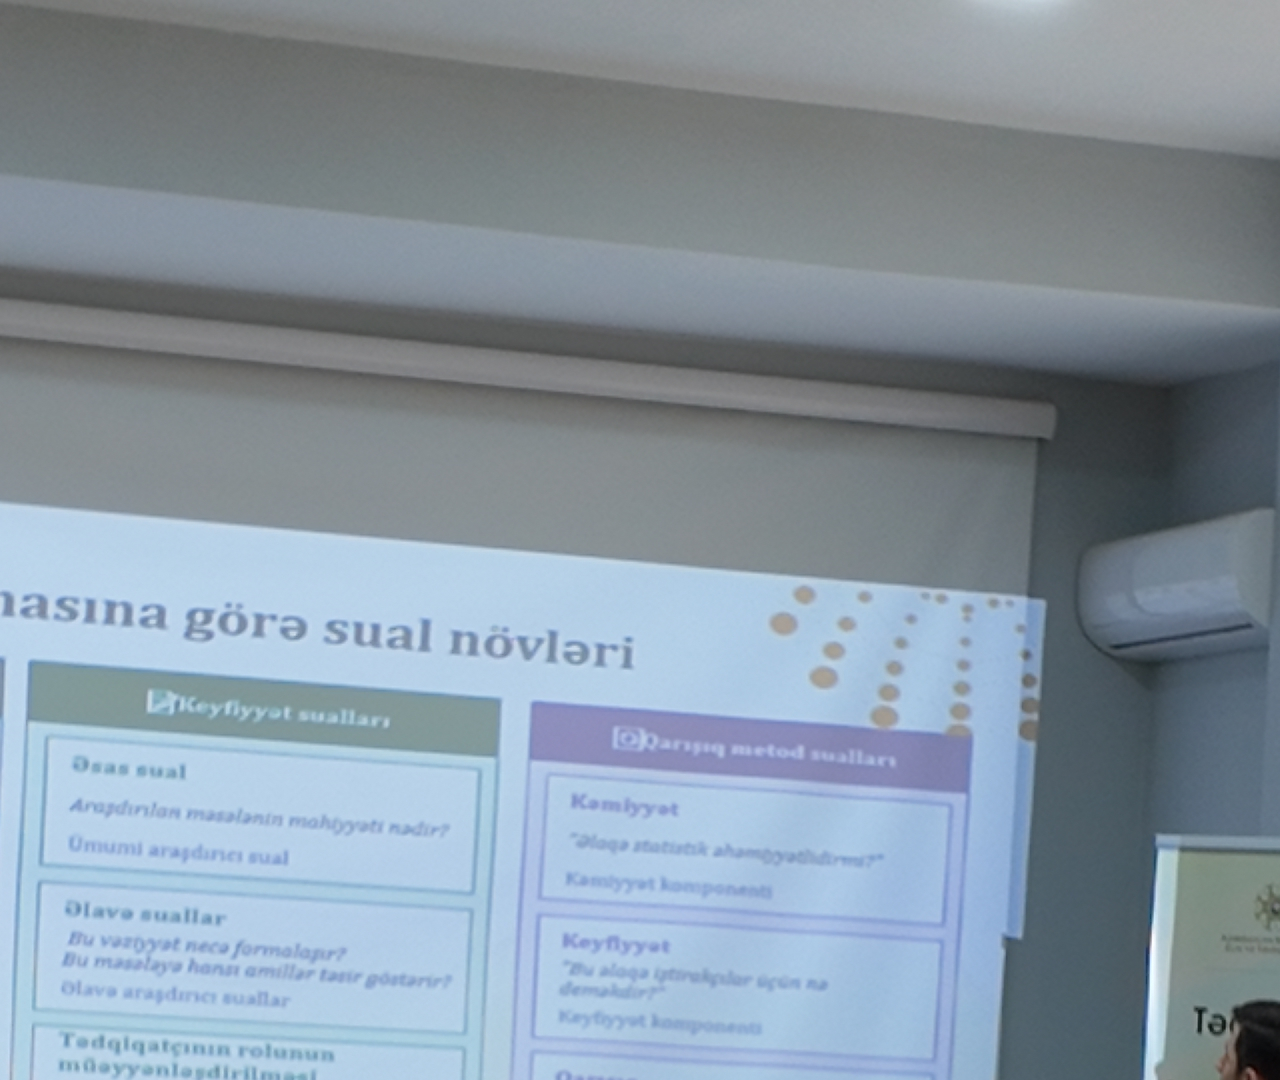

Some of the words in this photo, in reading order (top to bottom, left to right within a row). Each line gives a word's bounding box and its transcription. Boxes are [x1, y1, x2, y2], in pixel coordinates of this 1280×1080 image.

[184, 602, 308, 643] görə
[323, 618, 432, 653] sual
[450, 624, 636, 670] növləri
[178, 694, 291, 724] Keyfiyyət
[298, 708, 391, 729] sualları
[72, 754, 129, 777] Əsas
[136, 760, 187, 781] sual
[731, 740, 805, 762] metod
[811, 747, 898, 768] sualları
[570, 792, 679, 819] Kəmiyyət
[248, 848, 290, 867] sual
[65, 901, 134, 922] Əlavə
[140, 905, 227, 927] suallar
[562, 932, 671, 956] Keyfiyyət
[61, 980, 118, 999] Əlavə
[222, 989, 291, 1009] suallar
[60, 1030, 232, 1059] Tədqiqatçının
[237, 1043, 335, 1063] rolunun
